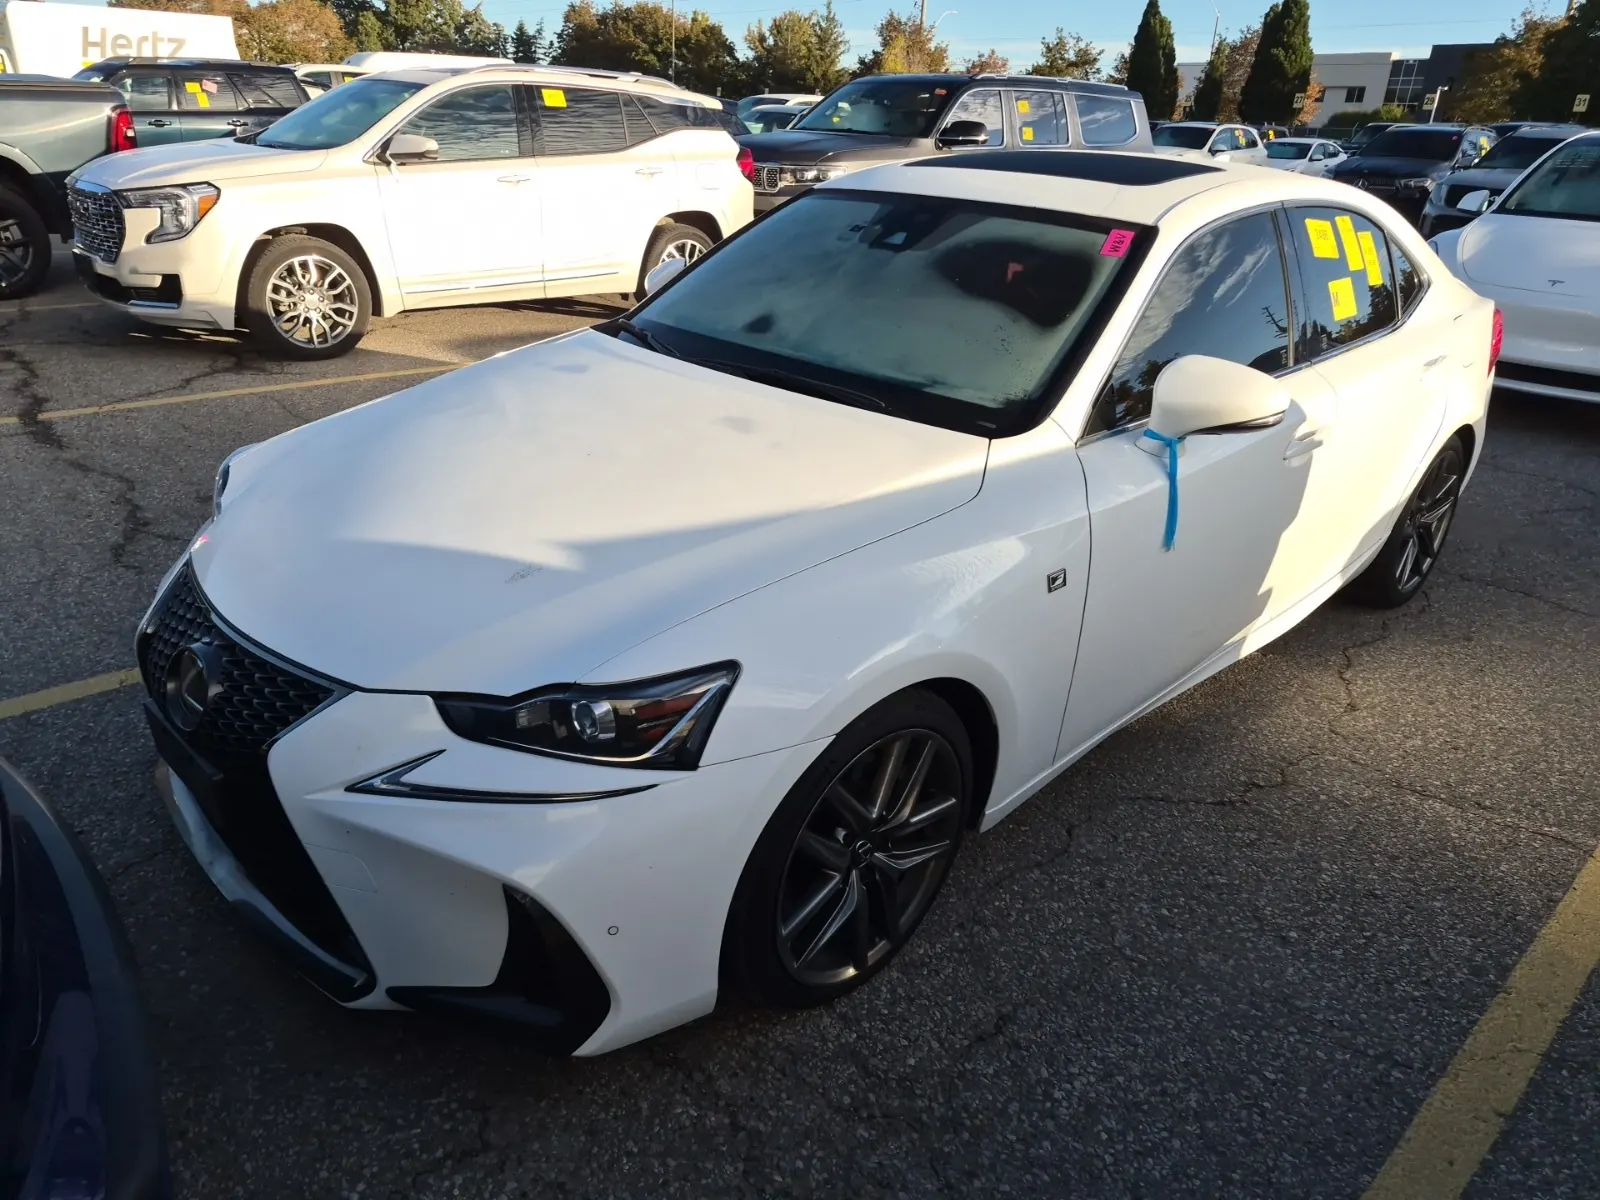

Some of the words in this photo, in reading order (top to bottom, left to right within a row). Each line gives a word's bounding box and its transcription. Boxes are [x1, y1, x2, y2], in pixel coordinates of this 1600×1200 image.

[82, 26, 186, 59] Hertz
[1294, 95, 1304, 104] 27
[1575, 97, 1587, 107] 31
